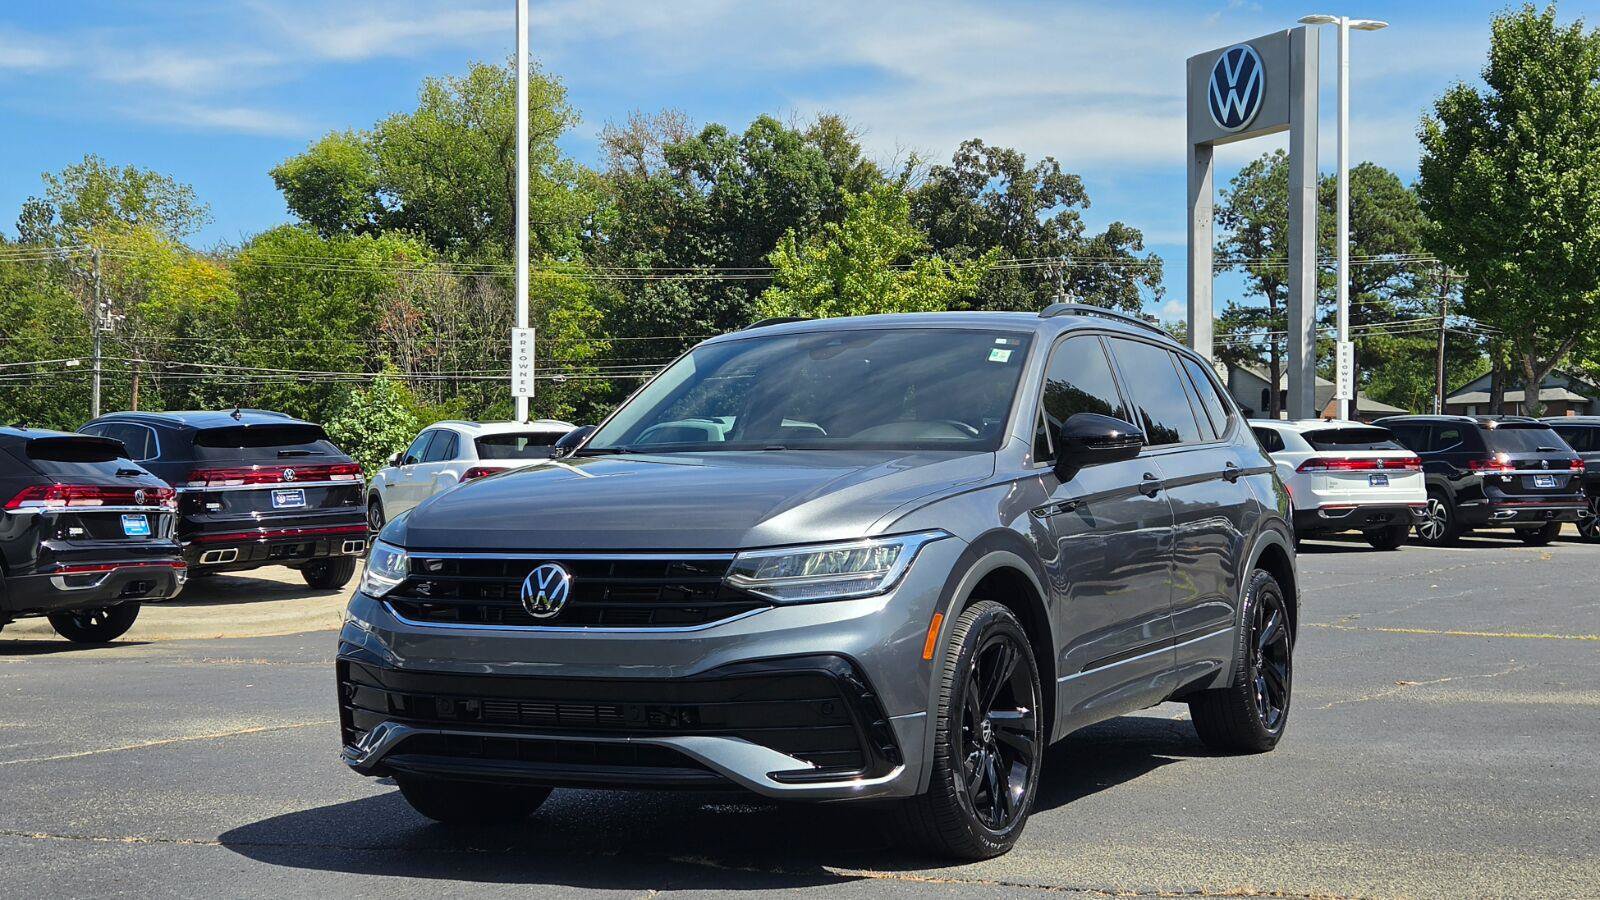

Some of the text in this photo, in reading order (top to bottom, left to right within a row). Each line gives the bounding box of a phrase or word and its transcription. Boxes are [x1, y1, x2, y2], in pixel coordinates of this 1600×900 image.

[1208, 44, 1264, 131] VW
[518, 332, 529, 393] PREOWNED
[1341, 345, 1349, 396] PREOWNED
[521, 564, 569, 618] VW
